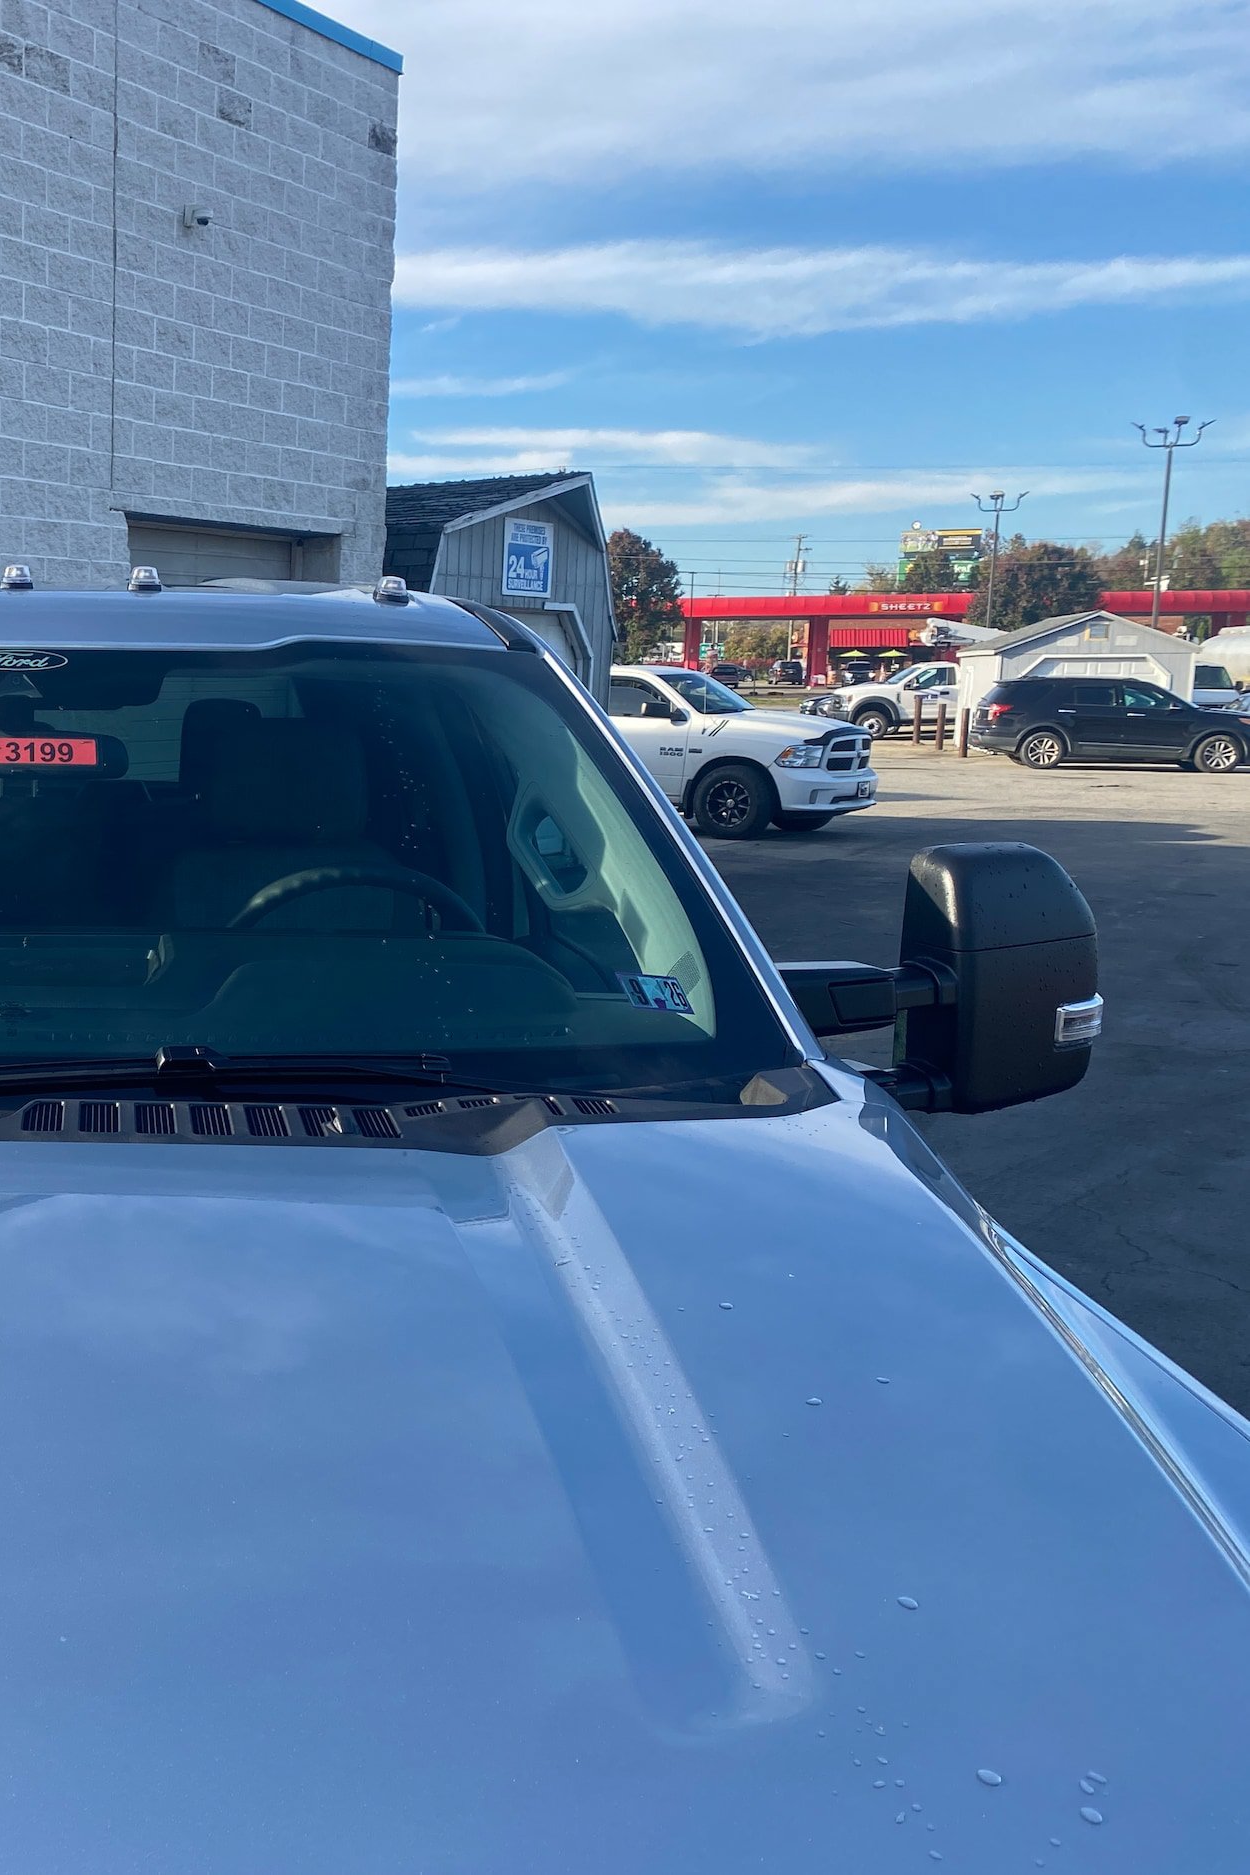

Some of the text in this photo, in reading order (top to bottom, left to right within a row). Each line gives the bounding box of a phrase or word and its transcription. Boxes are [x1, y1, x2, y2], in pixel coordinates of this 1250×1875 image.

[509, 555, 538, 580] 24 HOUR
[508, 578, 544, 591] SURVEILLANCE
[5, 741, 74, 762] 3199
[629, 979, 687, 1006] 9 26
